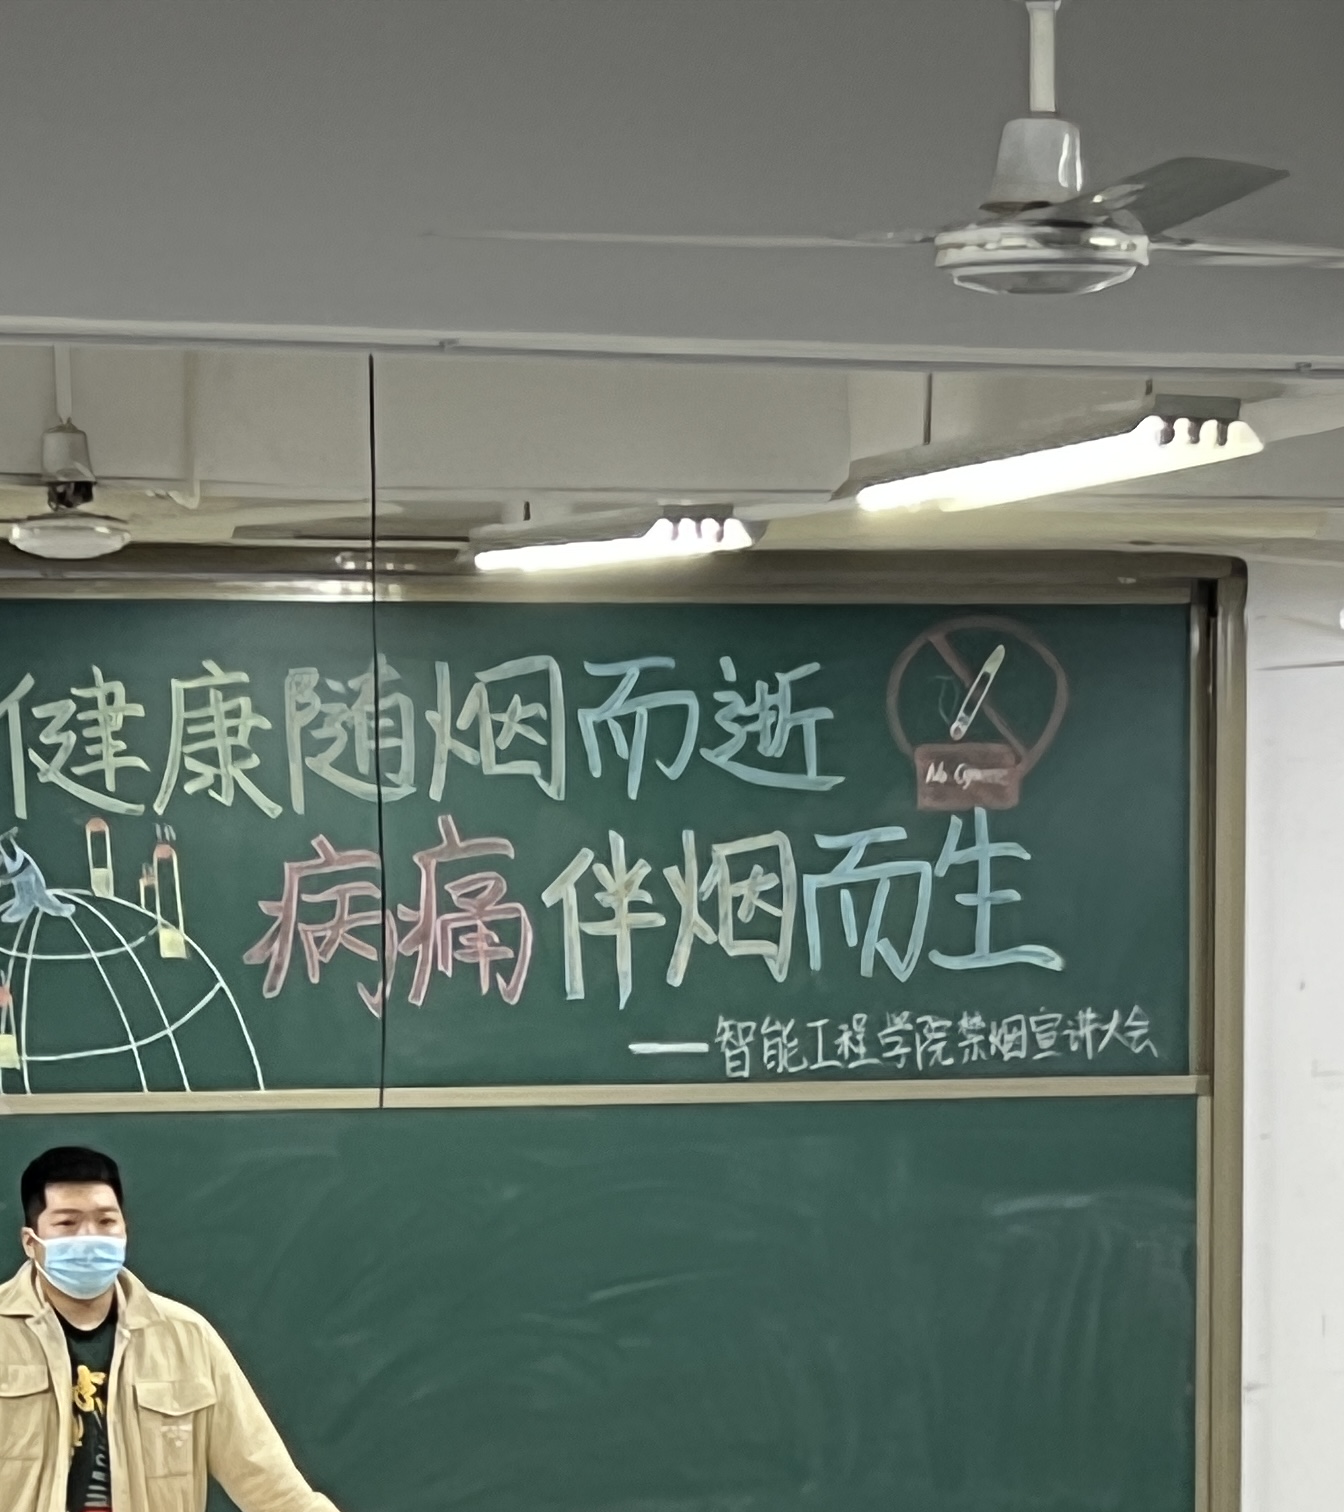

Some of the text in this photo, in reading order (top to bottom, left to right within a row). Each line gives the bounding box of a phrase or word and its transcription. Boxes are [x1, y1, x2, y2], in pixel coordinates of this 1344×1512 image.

[243, 806, 1065, 1019] 病痛伴烟而生
